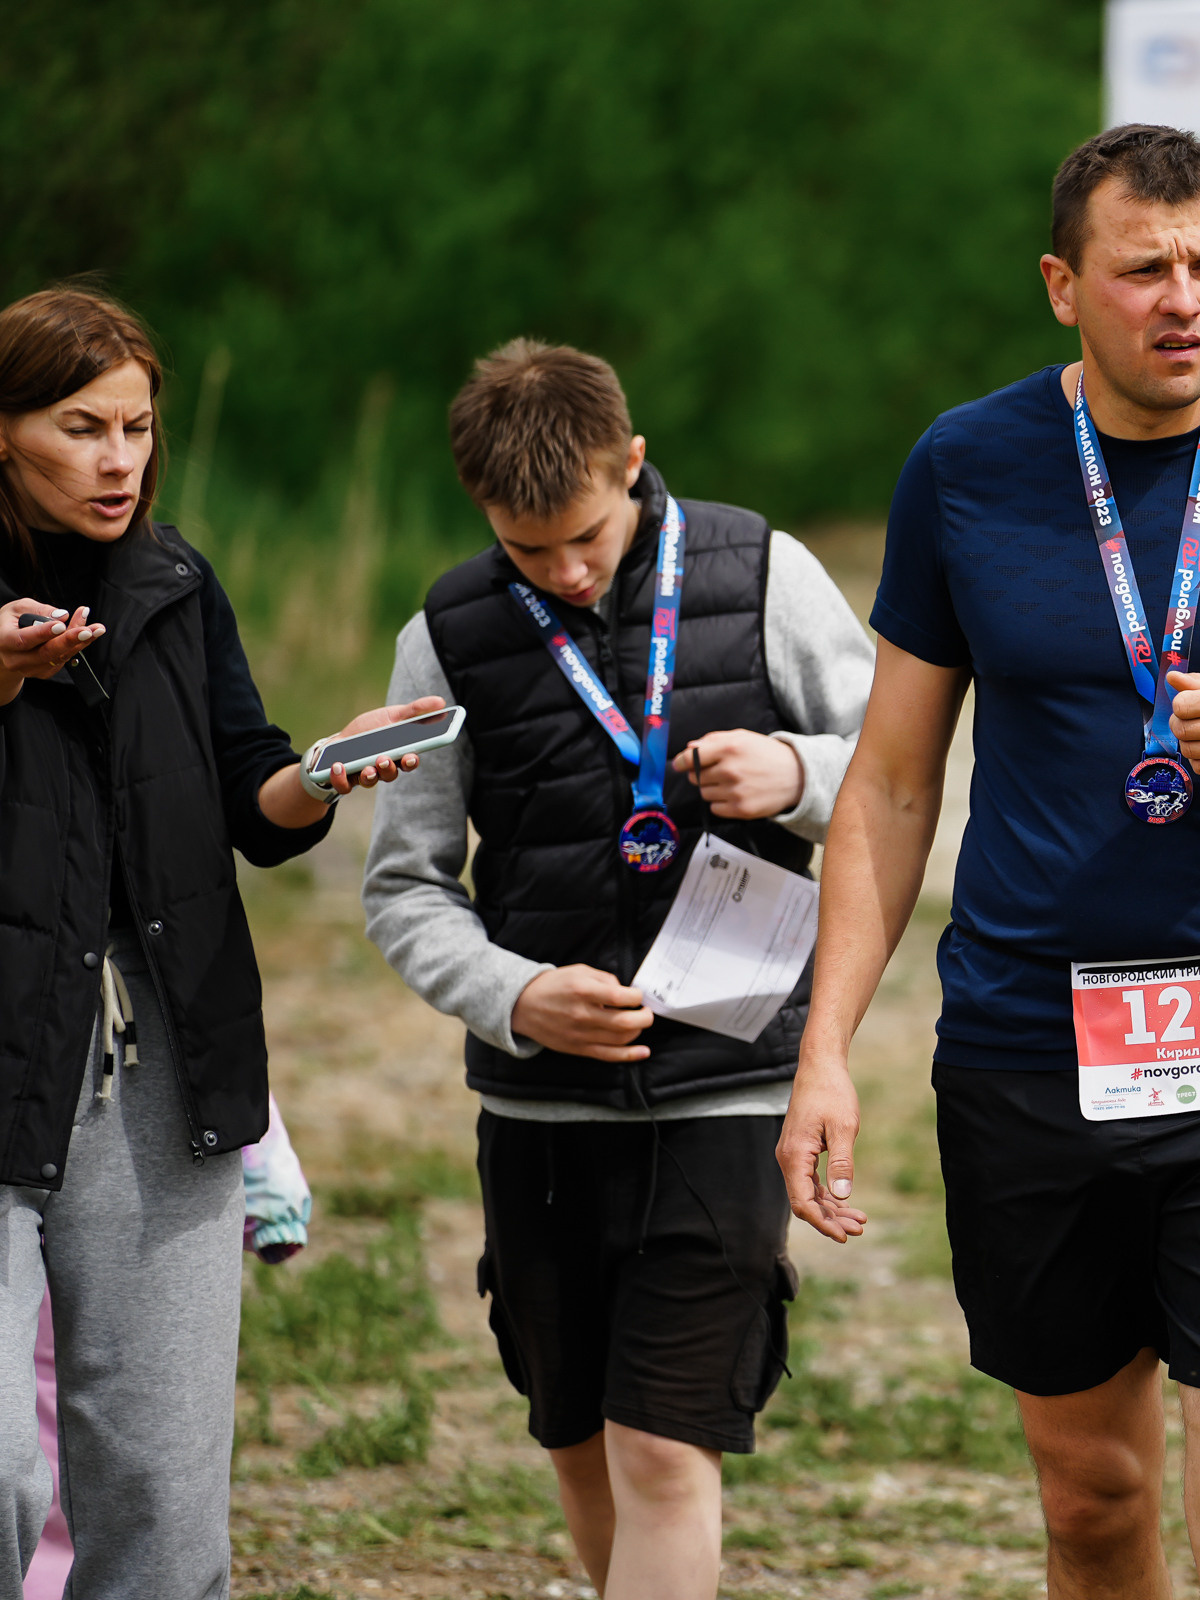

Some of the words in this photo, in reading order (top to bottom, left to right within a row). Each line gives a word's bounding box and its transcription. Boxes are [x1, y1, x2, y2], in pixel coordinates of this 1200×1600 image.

[1076, 410, 1102, 487] ТРИАТЛОН
[1092, 488, 1112, 527] 2023
[525, 594, 551, 627] 2023
[1147, 816, 1166, 824] 2023
[1082, 969, 1179, 985] НОВГОРОДСКИЙ
